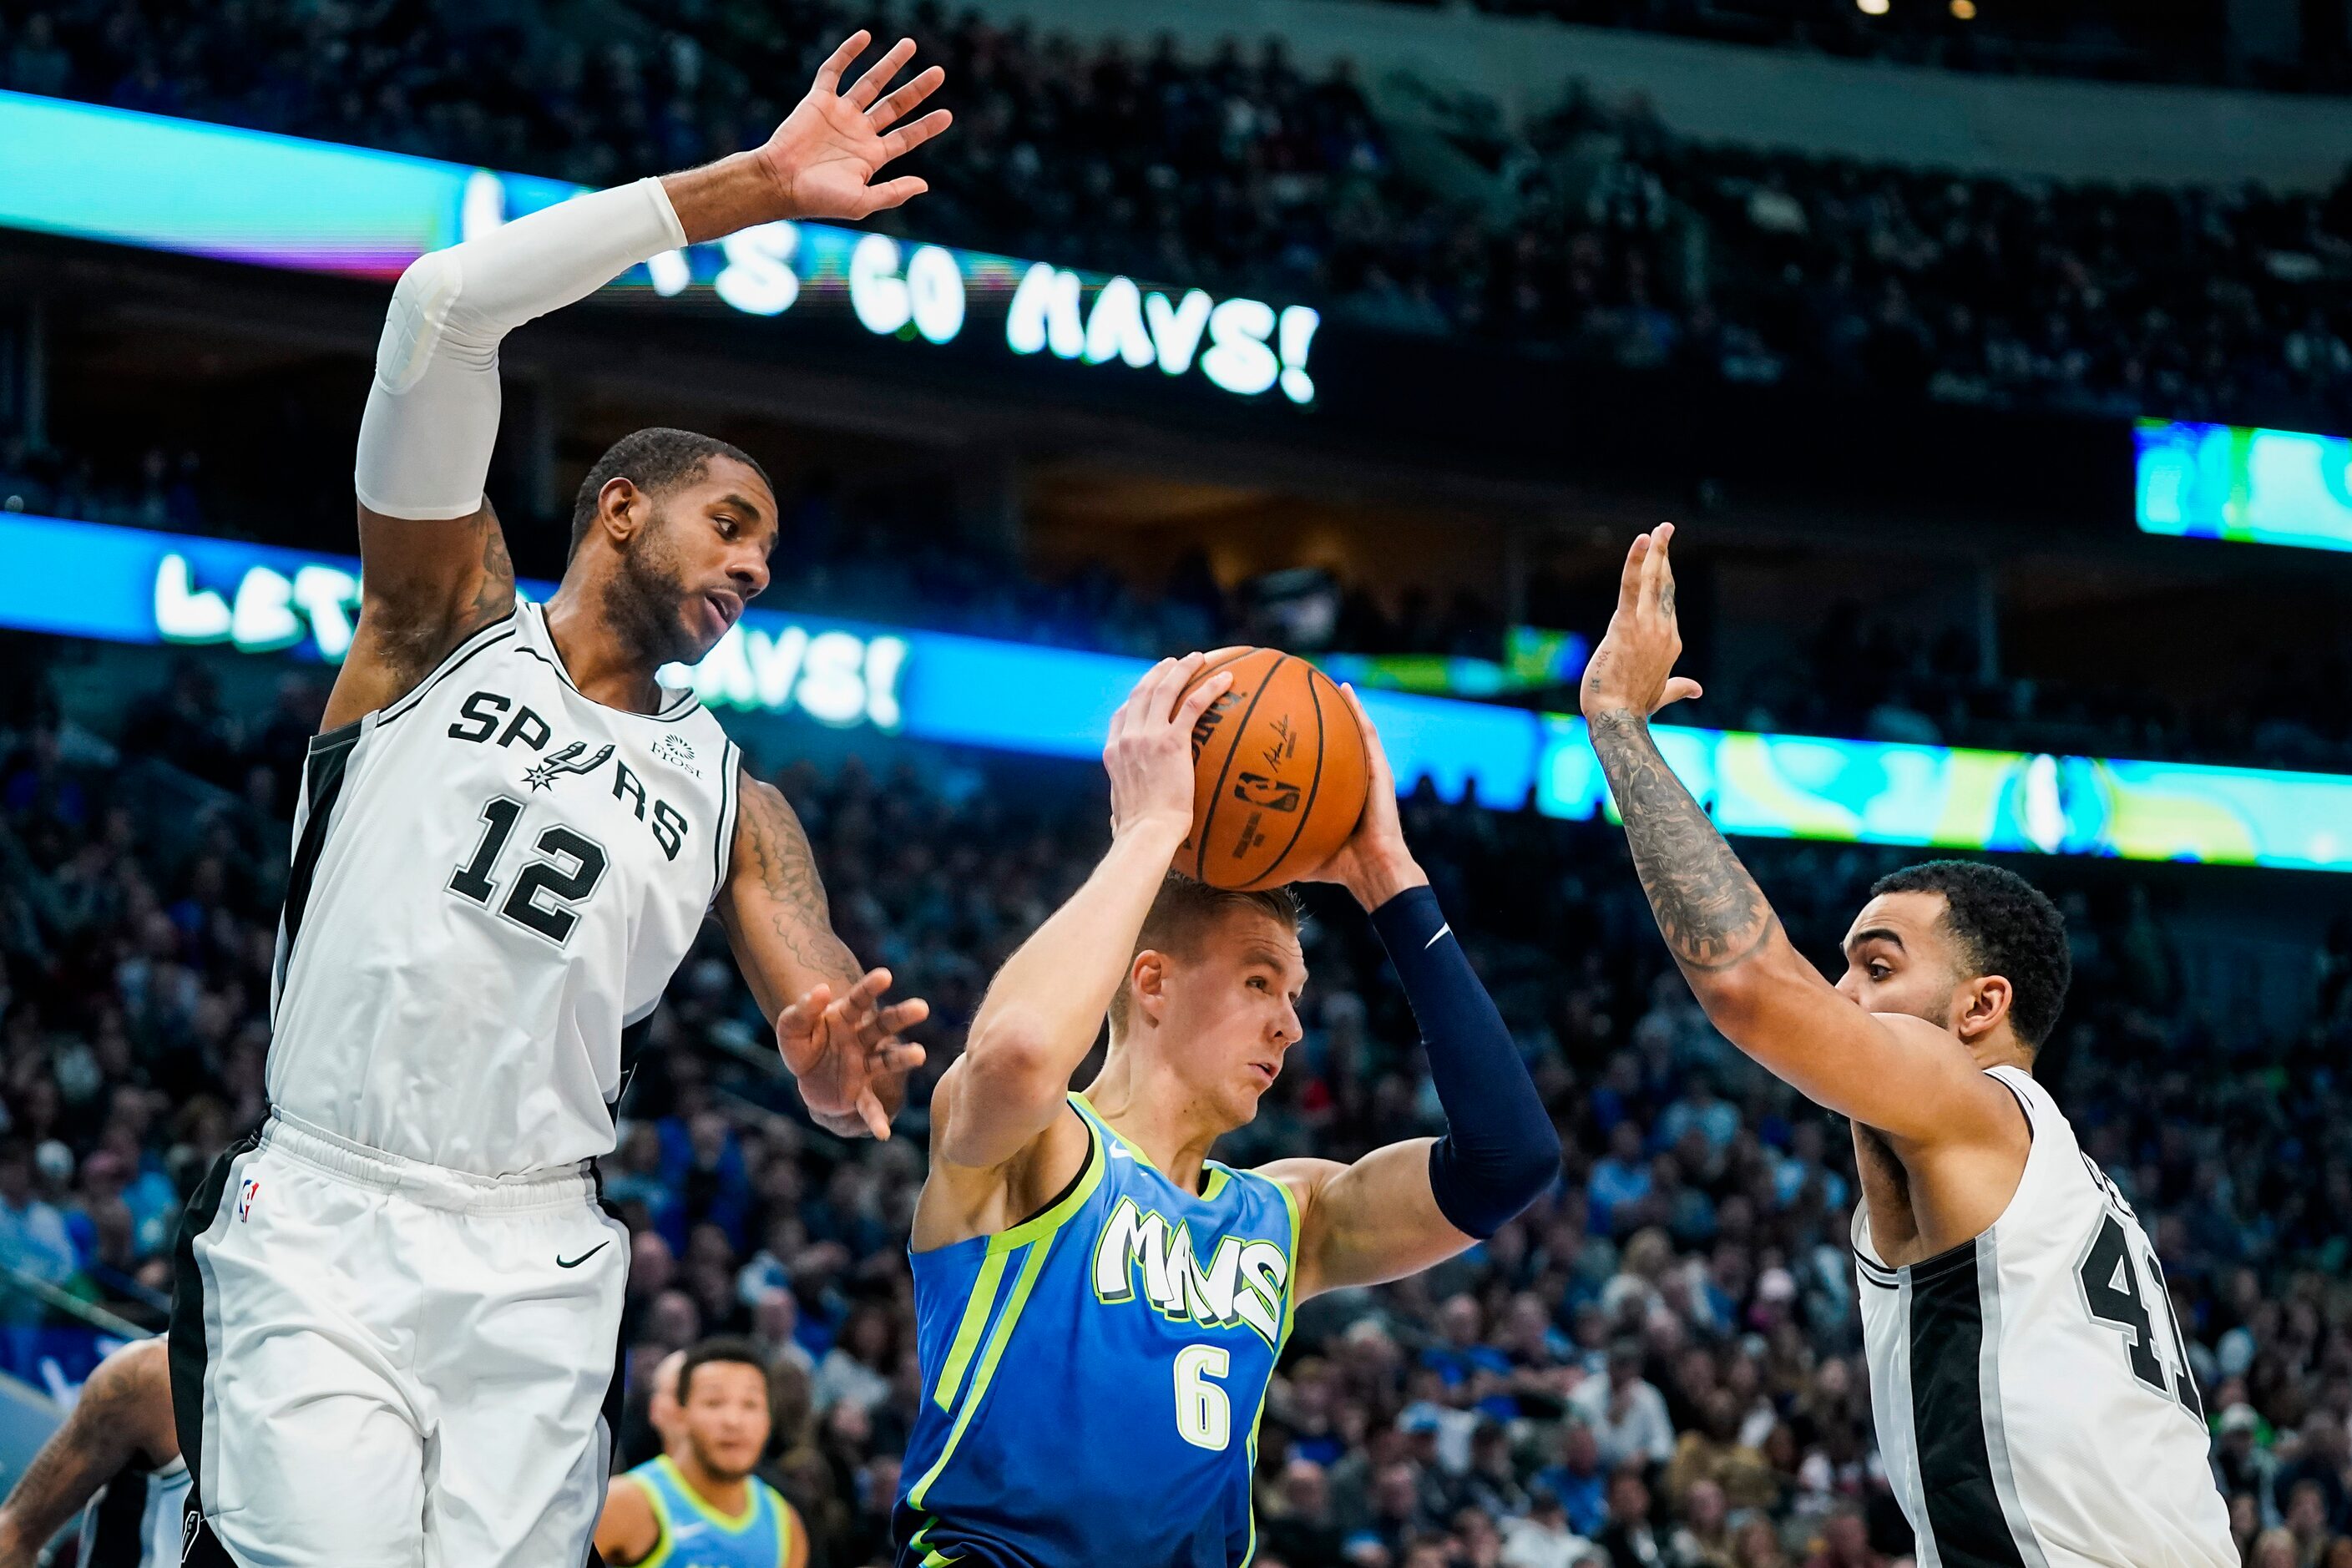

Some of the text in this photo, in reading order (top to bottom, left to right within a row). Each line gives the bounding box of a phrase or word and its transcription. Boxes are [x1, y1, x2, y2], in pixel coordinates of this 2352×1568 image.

[848, 233, 965, 345] GO
[1007, 261, 1320, 403] MAVS!
[655, 625, 902, 731] AVS!
[650, 740, 704, 780] Frost
[443, 794, 611, 950] 12
[1093, 1195, 1289, 1353] MAVS
[2073, 1204, 2209, 1434] 41
[1173, 1343, 1231, 1451] 6
